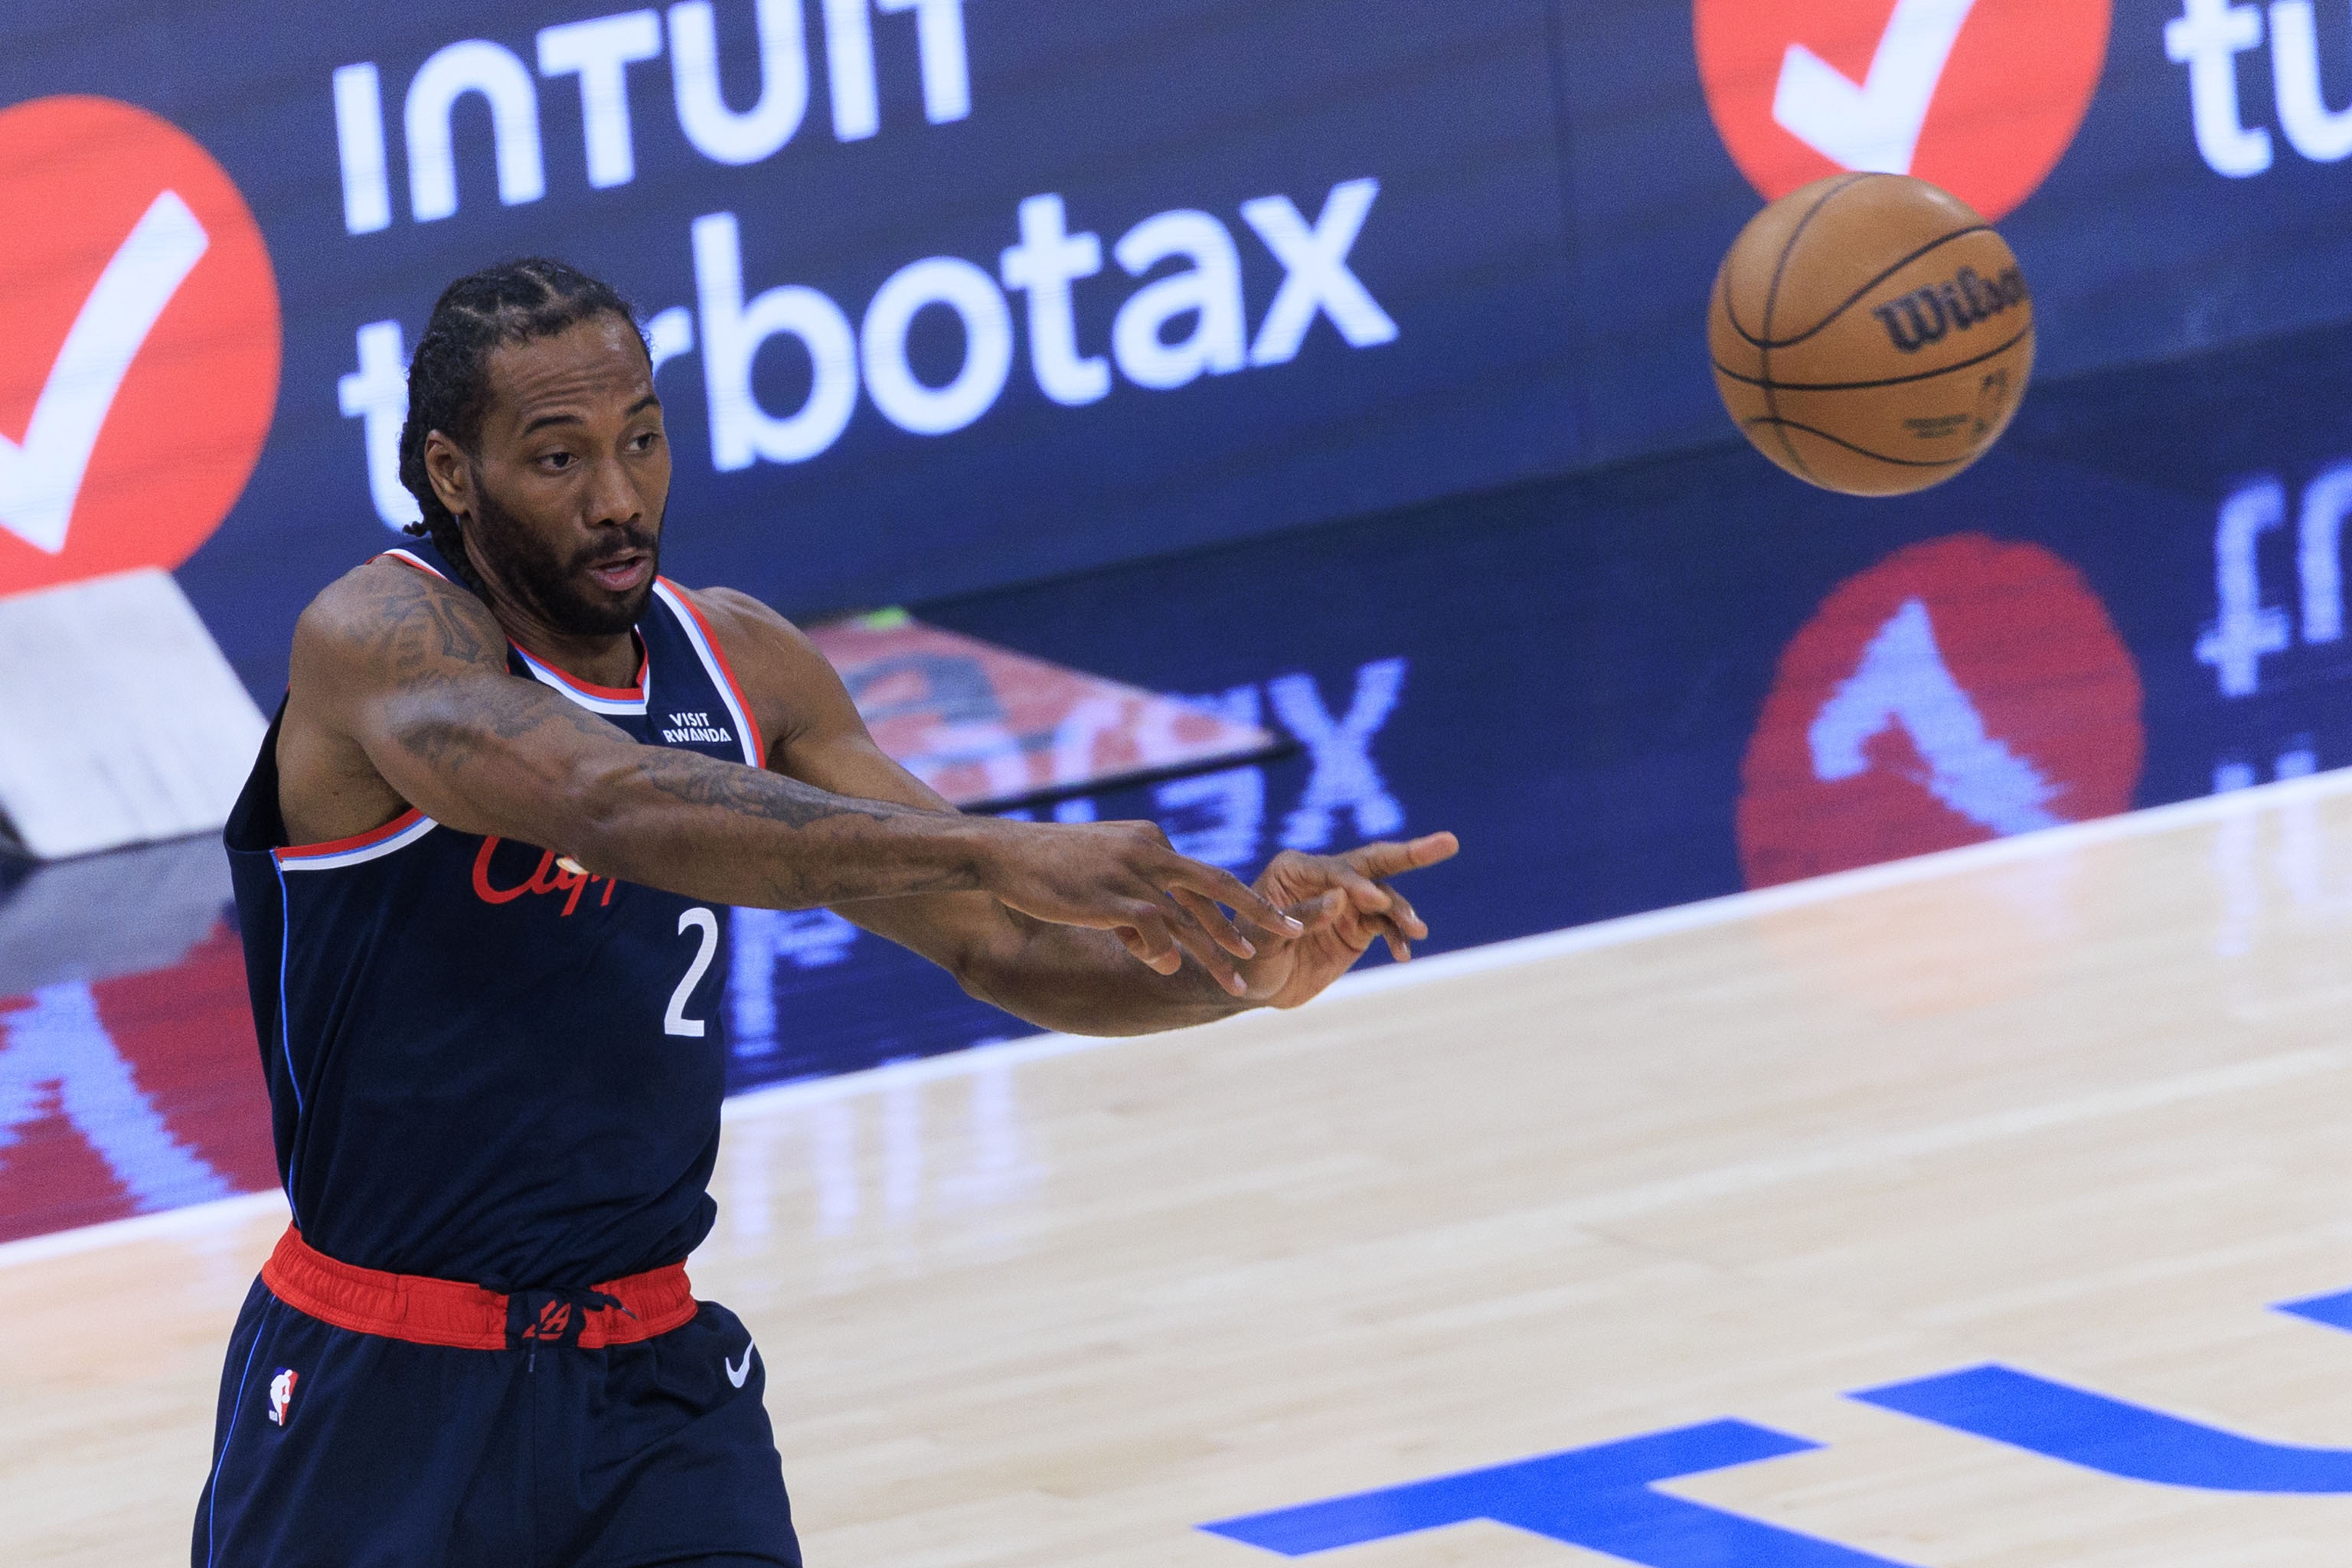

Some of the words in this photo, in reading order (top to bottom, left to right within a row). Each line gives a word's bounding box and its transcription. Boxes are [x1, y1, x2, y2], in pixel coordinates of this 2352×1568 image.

[332, 0, 971, 235] INTUIT
[338, 177, 1400, 537] tbotax
[662, 727, 733, 743] RWANDA
[668, 712, 710, 727] VISIT
[664, 906, 719, 1037] 2
